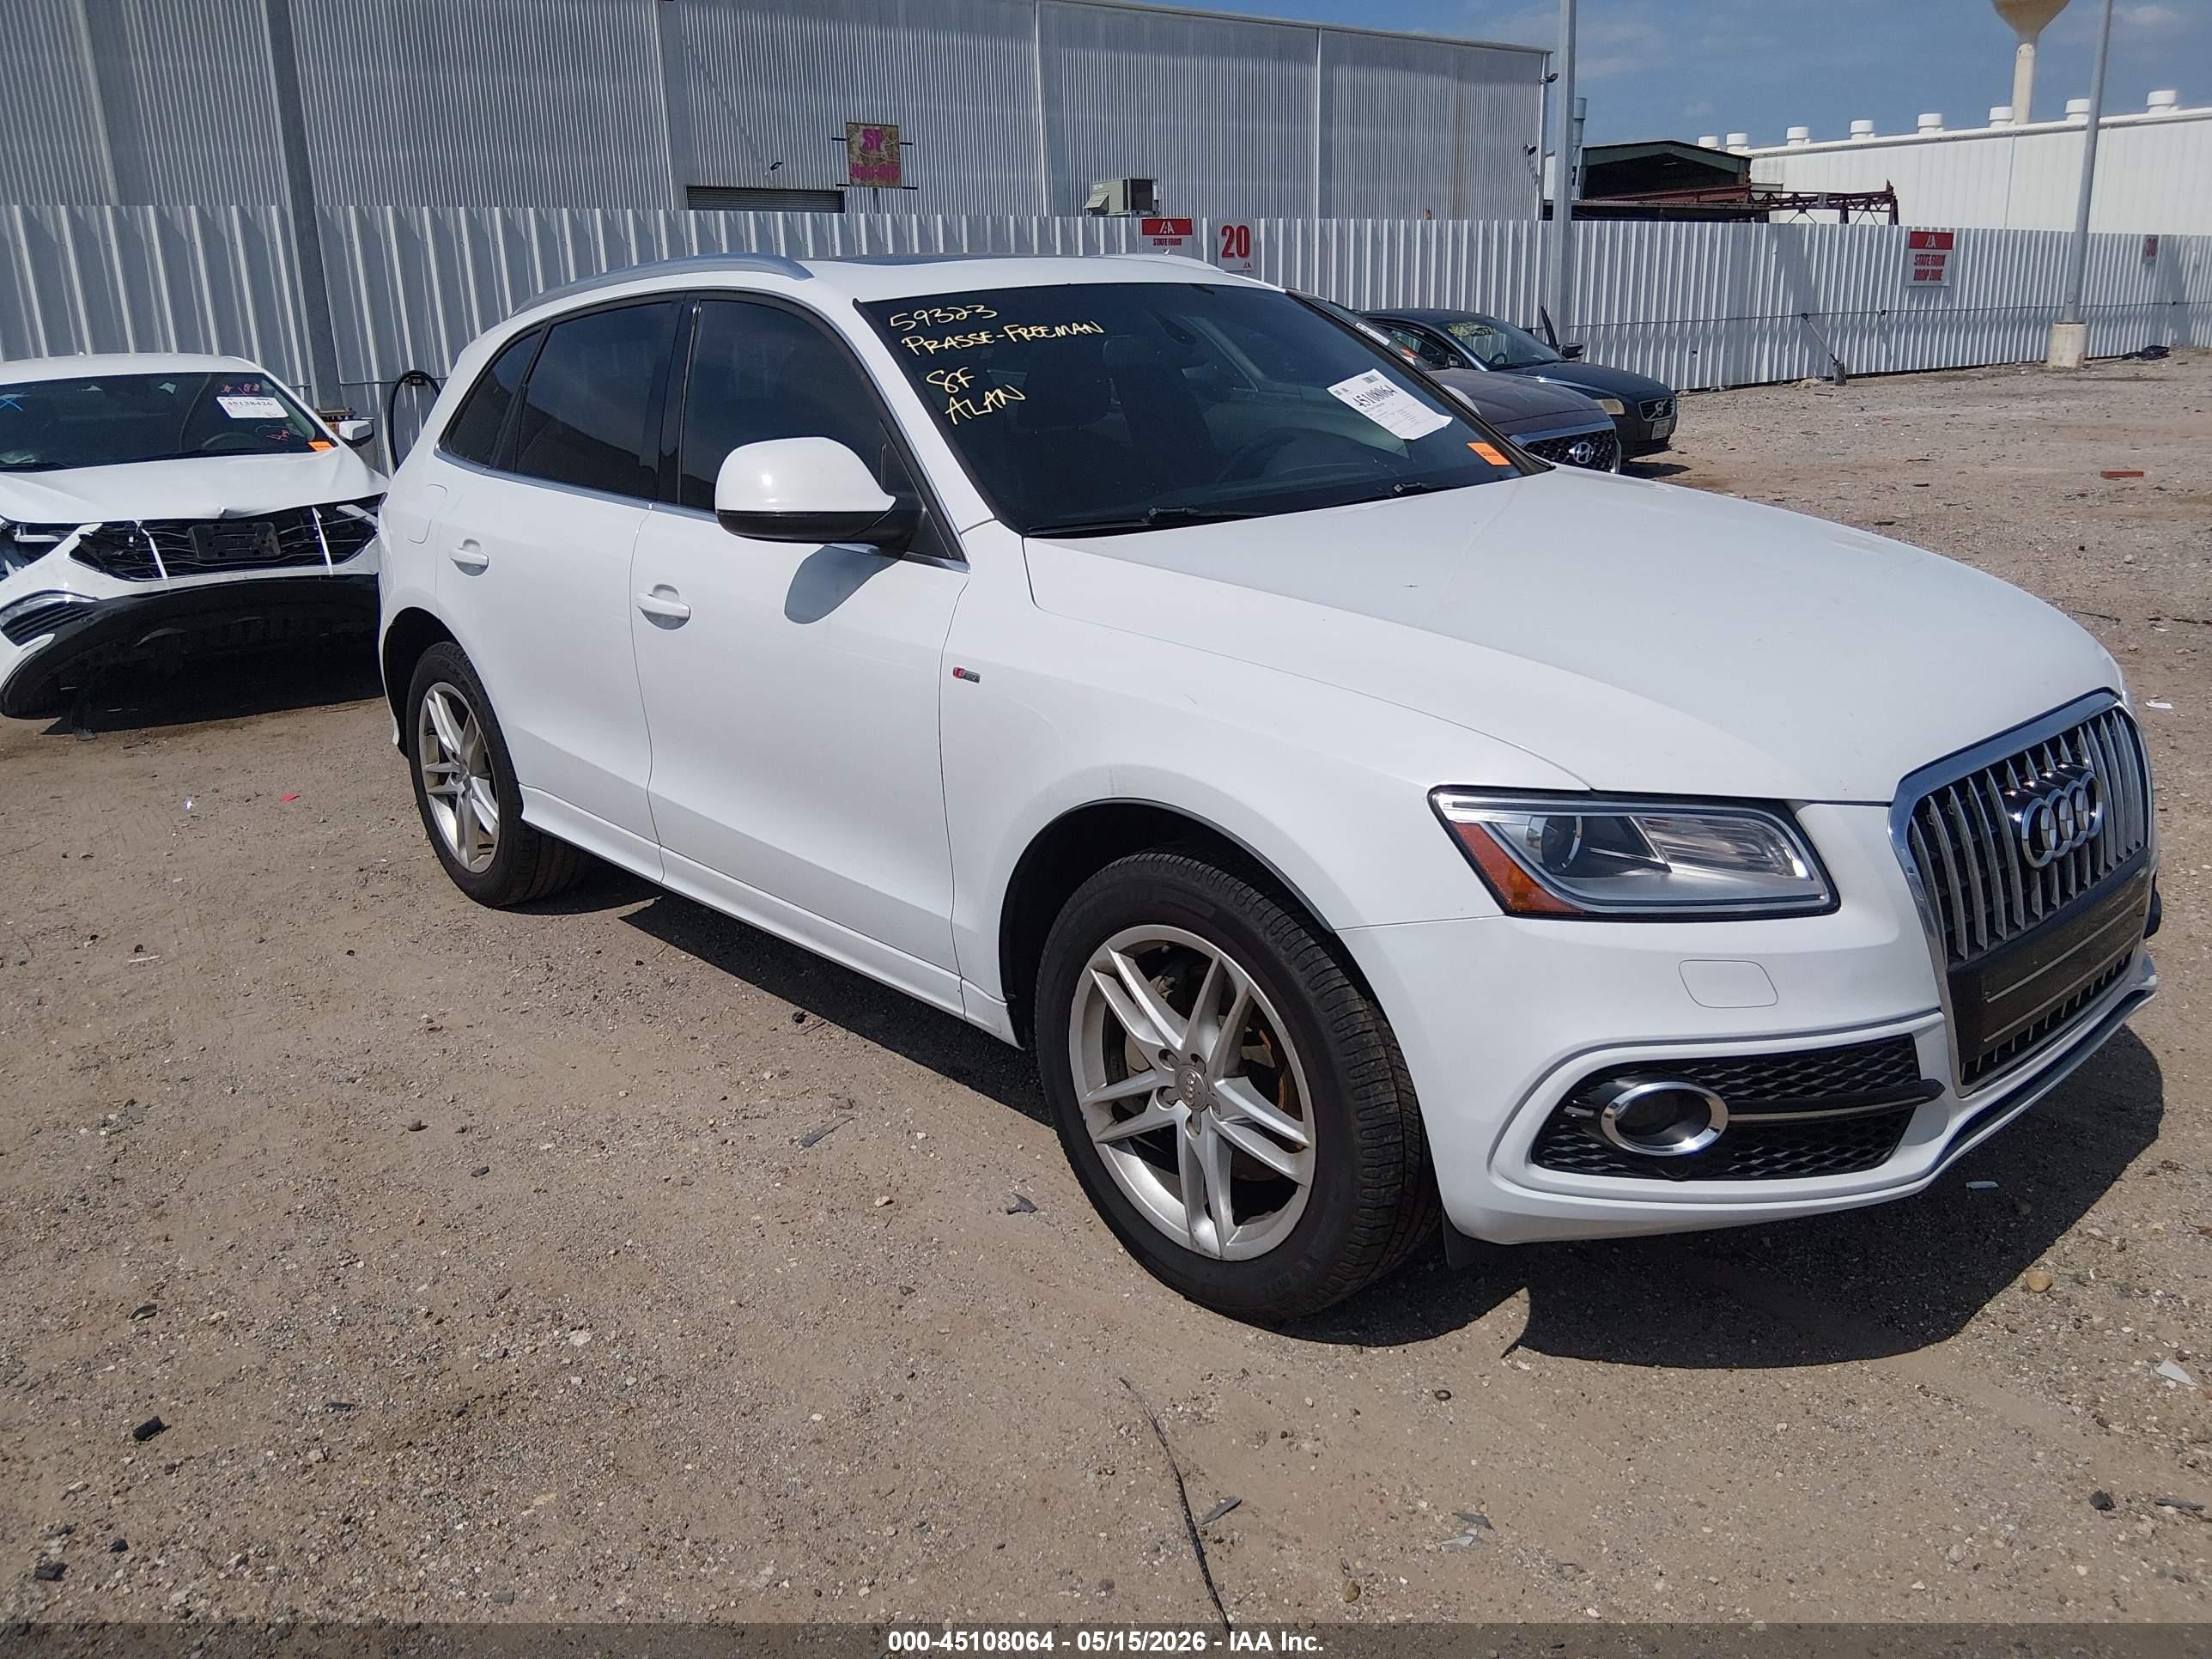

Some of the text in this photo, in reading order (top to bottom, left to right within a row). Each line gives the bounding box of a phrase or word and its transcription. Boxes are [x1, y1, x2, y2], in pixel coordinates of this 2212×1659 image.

[1221, 224, 1251, 258] 20
[890, 304, 998, 331] 59323
[901, 320, 1105, 356] PRASSE-FREEMAN
[945, 384, 1027, 425] ALAN
[1352, 383, 1397, 409] 45108064
